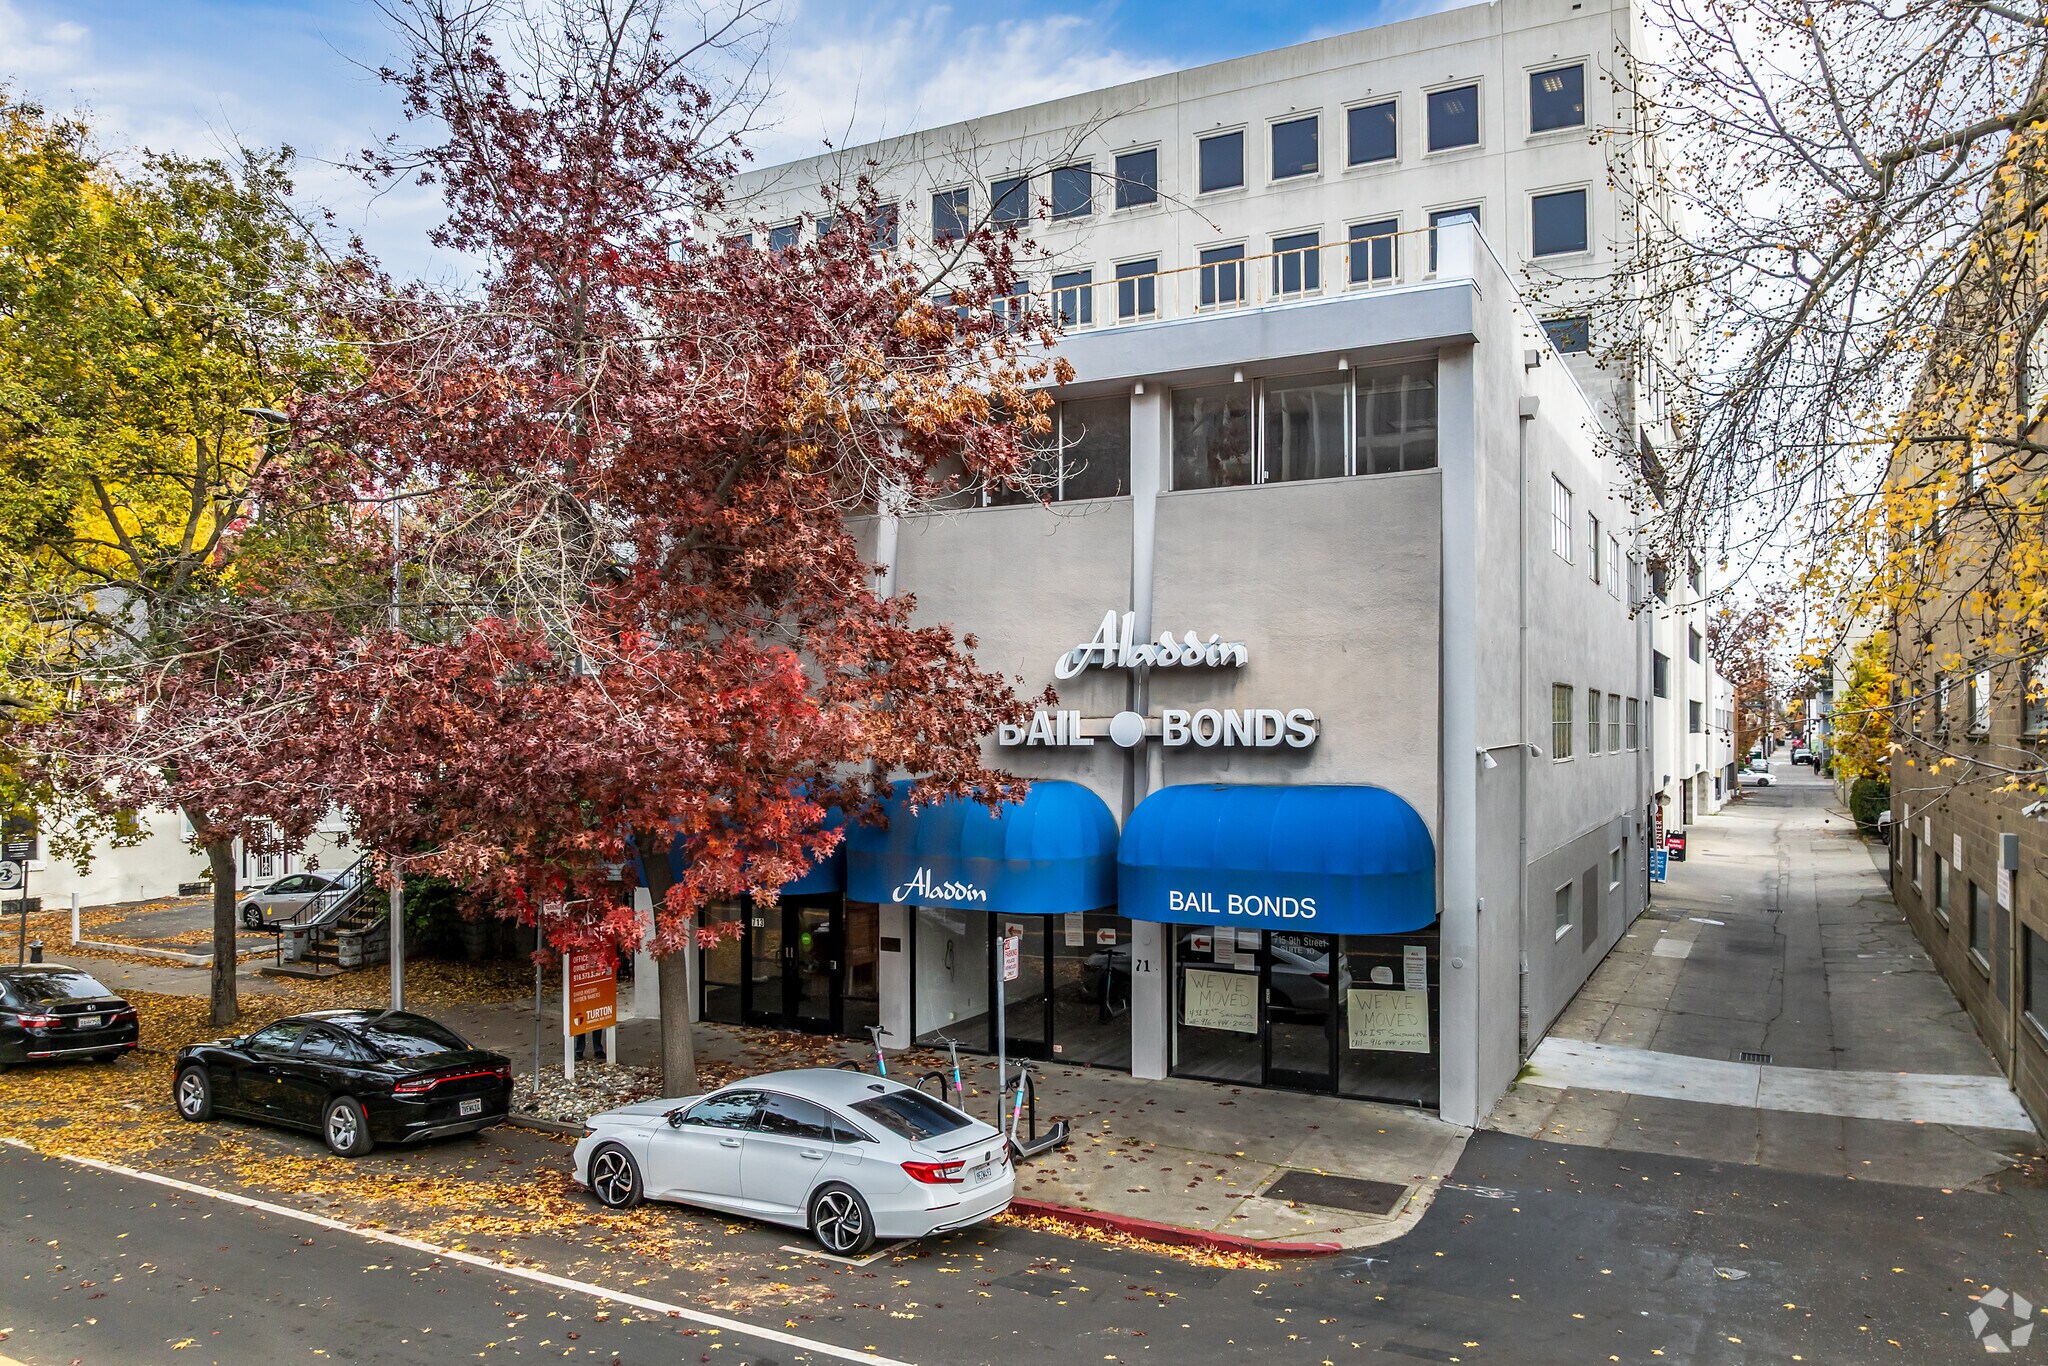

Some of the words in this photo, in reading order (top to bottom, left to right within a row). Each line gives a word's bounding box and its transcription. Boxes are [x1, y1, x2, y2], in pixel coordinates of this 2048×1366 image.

[1054, 609, 1248, 680] Aladdin
[998, 710, 1094, 747] BAIL
[1163, 708, 1320, 748] BONDS
[892, 866, 987, 902] Aladdin
[1169, 890, 1220, 914] BAIL
[1228, 894, 1317, 919] BONDS
[1273, 935, 1286, 945] 715
[1289, 936, 1301, 946] 9th
[1303, 936, 1327, 947] Street
[1280, 945, 1303, 954] SUITE
[1199, 990, 1250, 1007] MOVED
[1355, 993, 1416, 1010] WE'VE
[586, 1005, 613, 1020] TURTON
[1364, 1011, 1419, 1029] MOVED
